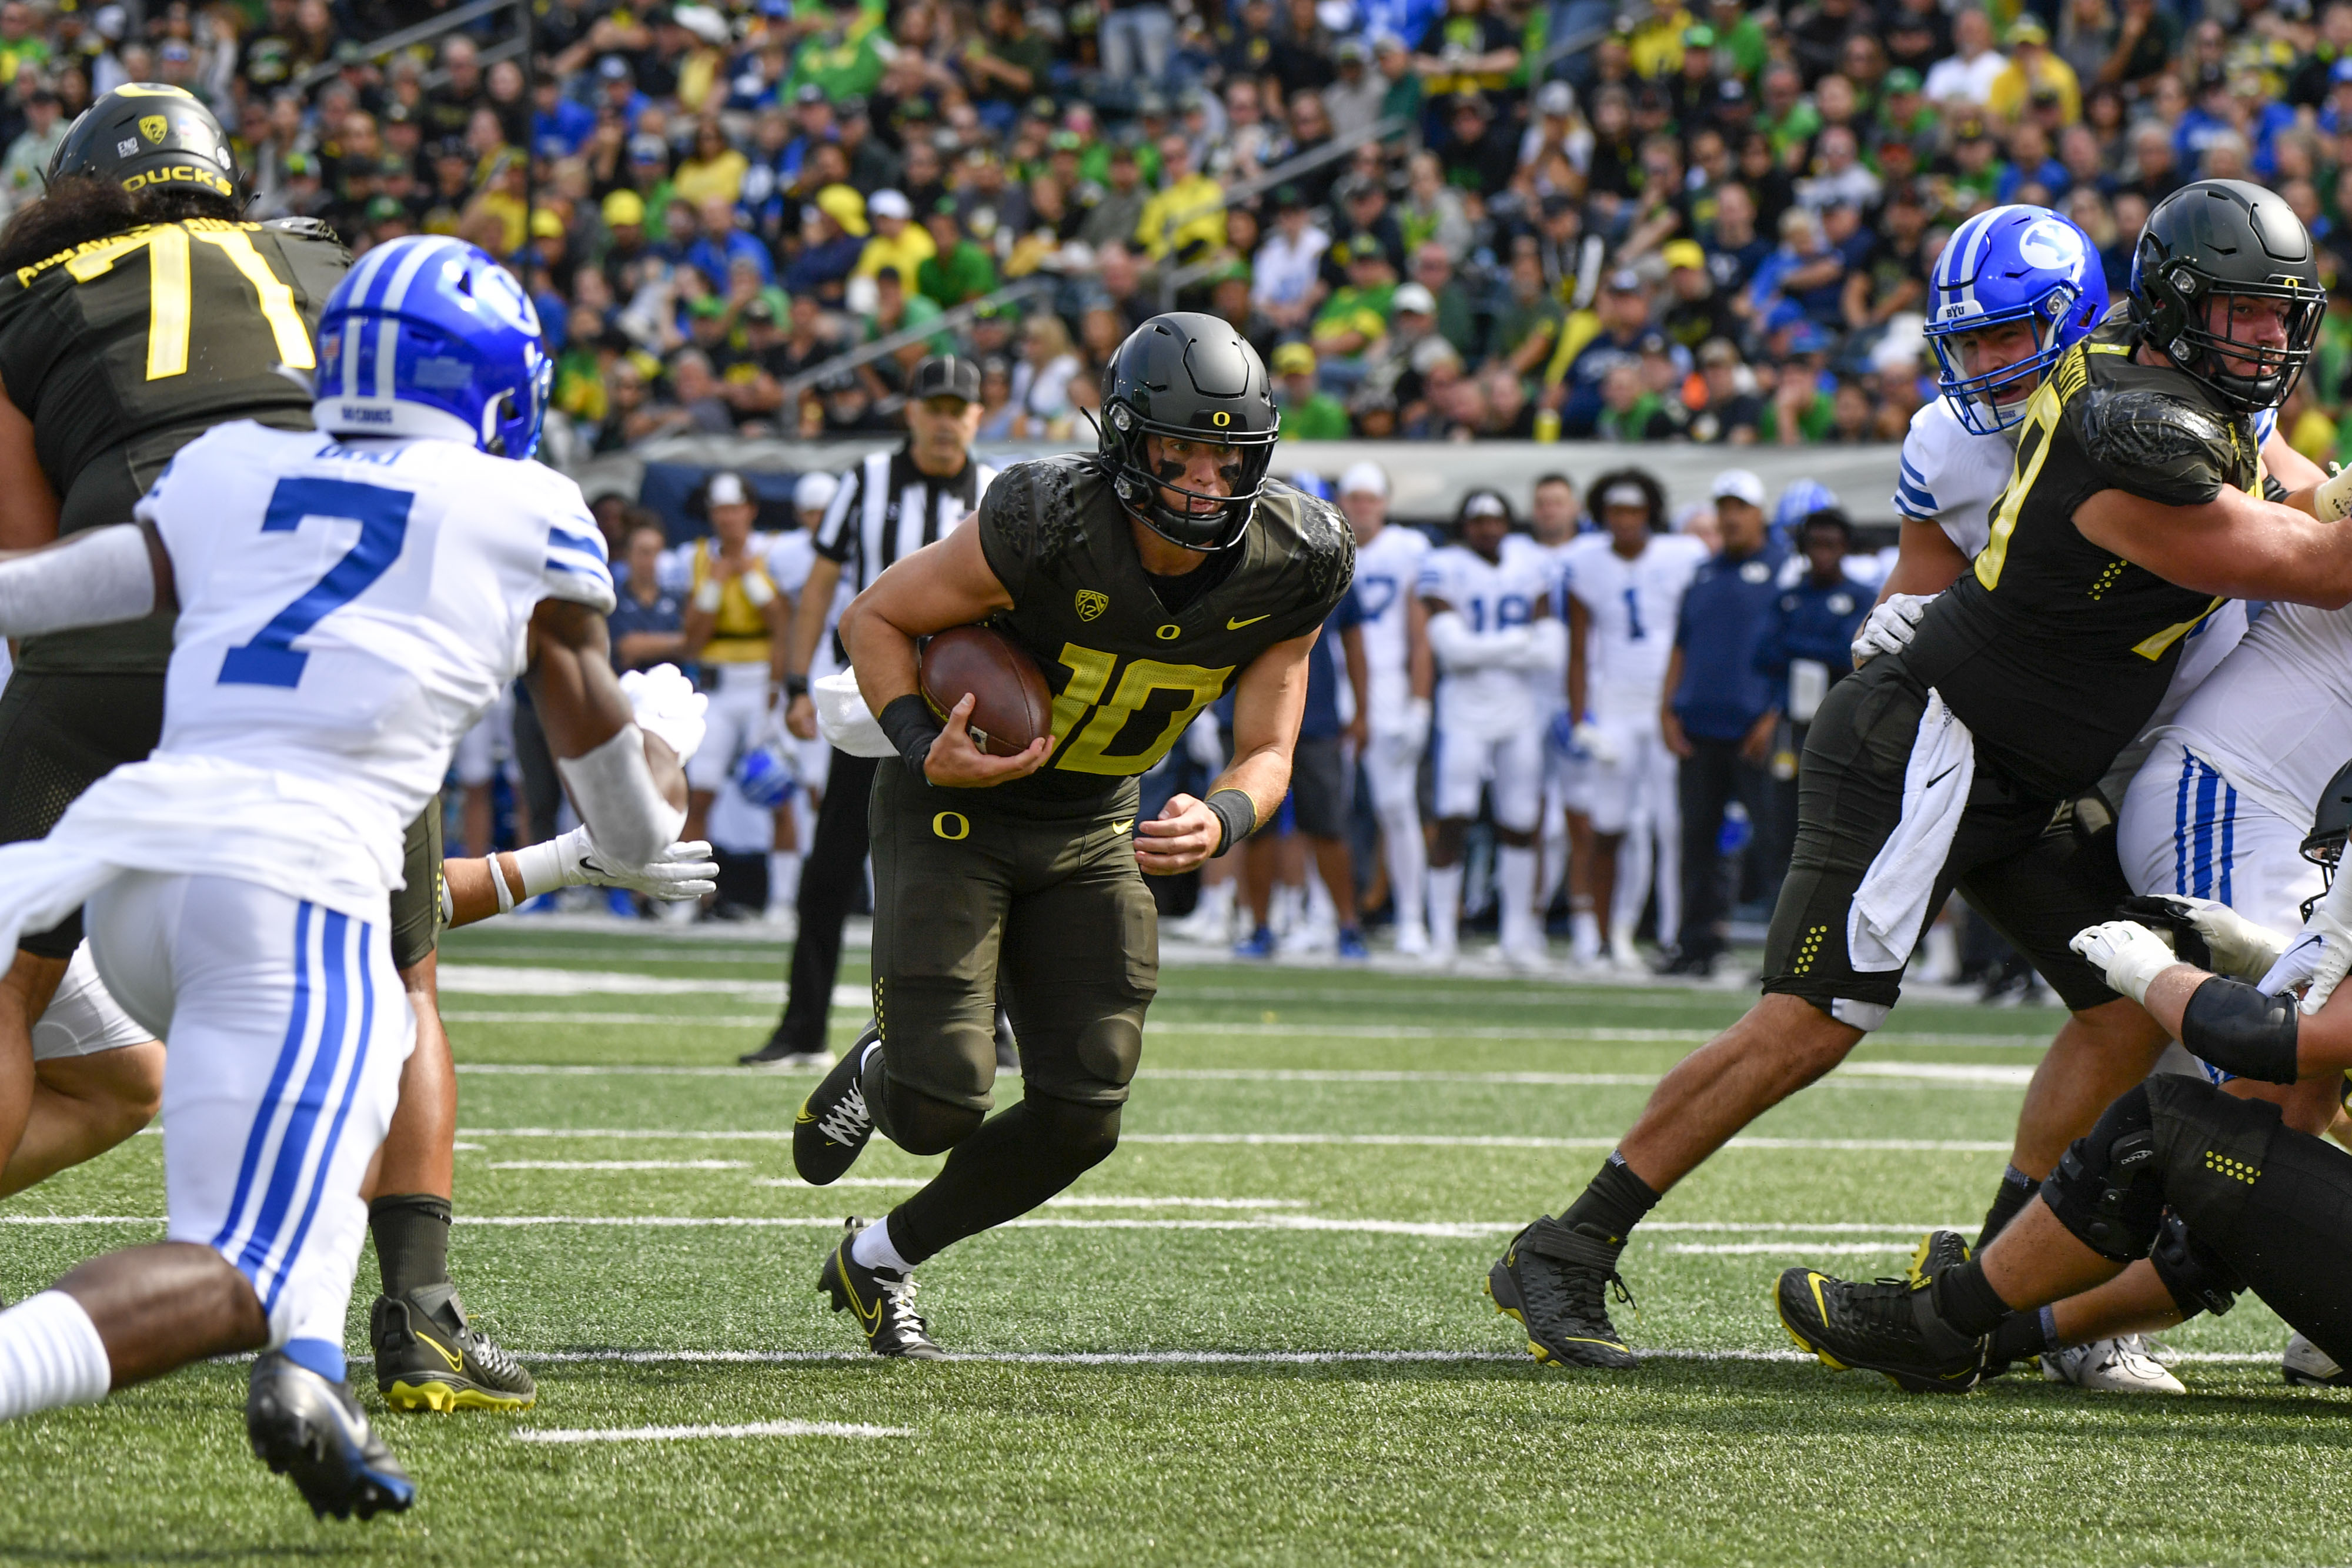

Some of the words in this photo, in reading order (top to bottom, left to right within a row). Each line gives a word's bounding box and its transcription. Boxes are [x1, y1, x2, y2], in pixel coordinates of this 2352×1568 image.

[122, 166, 233, 196] DUCKS
[1946, 305, 1965, 318] BYU
[1212, 412, 1231, 427] O
[217, 477, 415, 689] 7
[1078, 591, 1107, 612] PAC
[1080, 604, 1097, 617] 12
[1624, 588, 1648, 639] 1
[1155, 624, 1181, 640] O
[1041, 641, 1237, 776] 10
[933, 811, 970, 840] O
